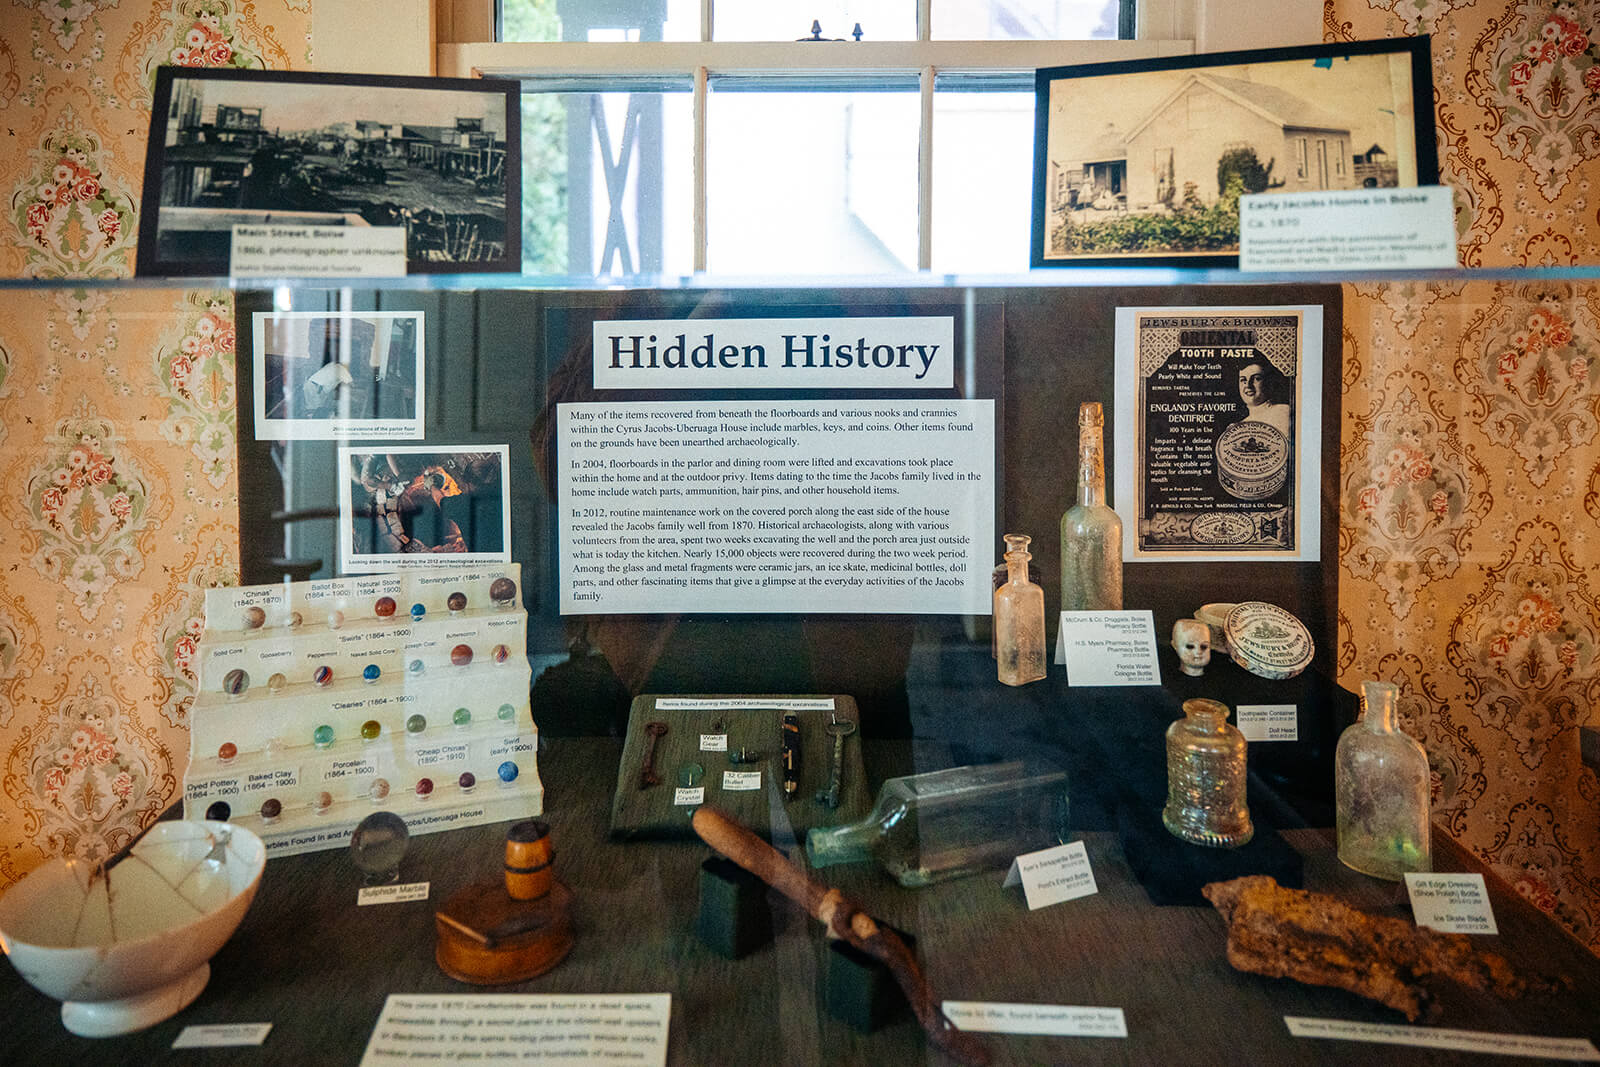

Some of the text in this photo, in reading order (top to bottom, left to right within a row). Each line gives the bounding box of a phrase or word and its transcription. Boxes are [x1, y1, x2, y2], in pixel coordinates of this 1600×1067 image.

[1390, 194, 1428, 204] Boise
[1181, 329, 1256, 346] ORIENTAL
[608, 334, 940, 380] Hidden History
[1180, 348, 1255, 358] TOOTH PASTE
[1167, 363, 1179, 371] Will
[1179, 363, 1193, 371] Make
[1193, 363, 1206, 371] Your
[1193, 372, 1203, 380] and
[570, 405, 958, 422] Many of the items recovered from beneath the floorboards and various nooks and crannies
[1150, 402, 1237, 413] ENGLAND'S FAVORITE
[1168, 414, 1215, 424] DENTIFRICE
[570, 420, 974, 436] within the Cyrus Jacobs-Uberuaga House include marbles, keys, and coins. Other items found
[583, 437, 598, 447] the
[599, 437, 635, 450] grounds
[636, 436, 658, 447] have
[658, 436, 680, 447] been
[681, 436, 725, 446] unearthed
[726, 435, 800, 449] archaeologically.
[571, 458, 581, 468] In
[581, 458, 608, 470] 2004,
[609, 458, 659, 468] floorboards
[660, 458, 670, 468] in
[671, 457, 686, 468] the
[686, 457, 714, 471] parlor
[714, 457, 732, 468] and
[732, 457, 762, 471] dining
[811, 457, 835, 467] lifted
[836, 457, 853, 467] and
[854, 456, 907, 467] excavations
[908, 456, 928, 467] took
[930, 456, 954, 470] place
[570, 470, 982, 485] within the home and at the outdoor privy. Items dating to the time the Jacobs family lived in the
[249, 769, 293, 782] Baked Clay
[187, 778, 239, 793] Dyed Pottery
[265, 840, 289, 850] arbles
[290, 836, 316, 848] Found
[460, 808, 483, 819] House
